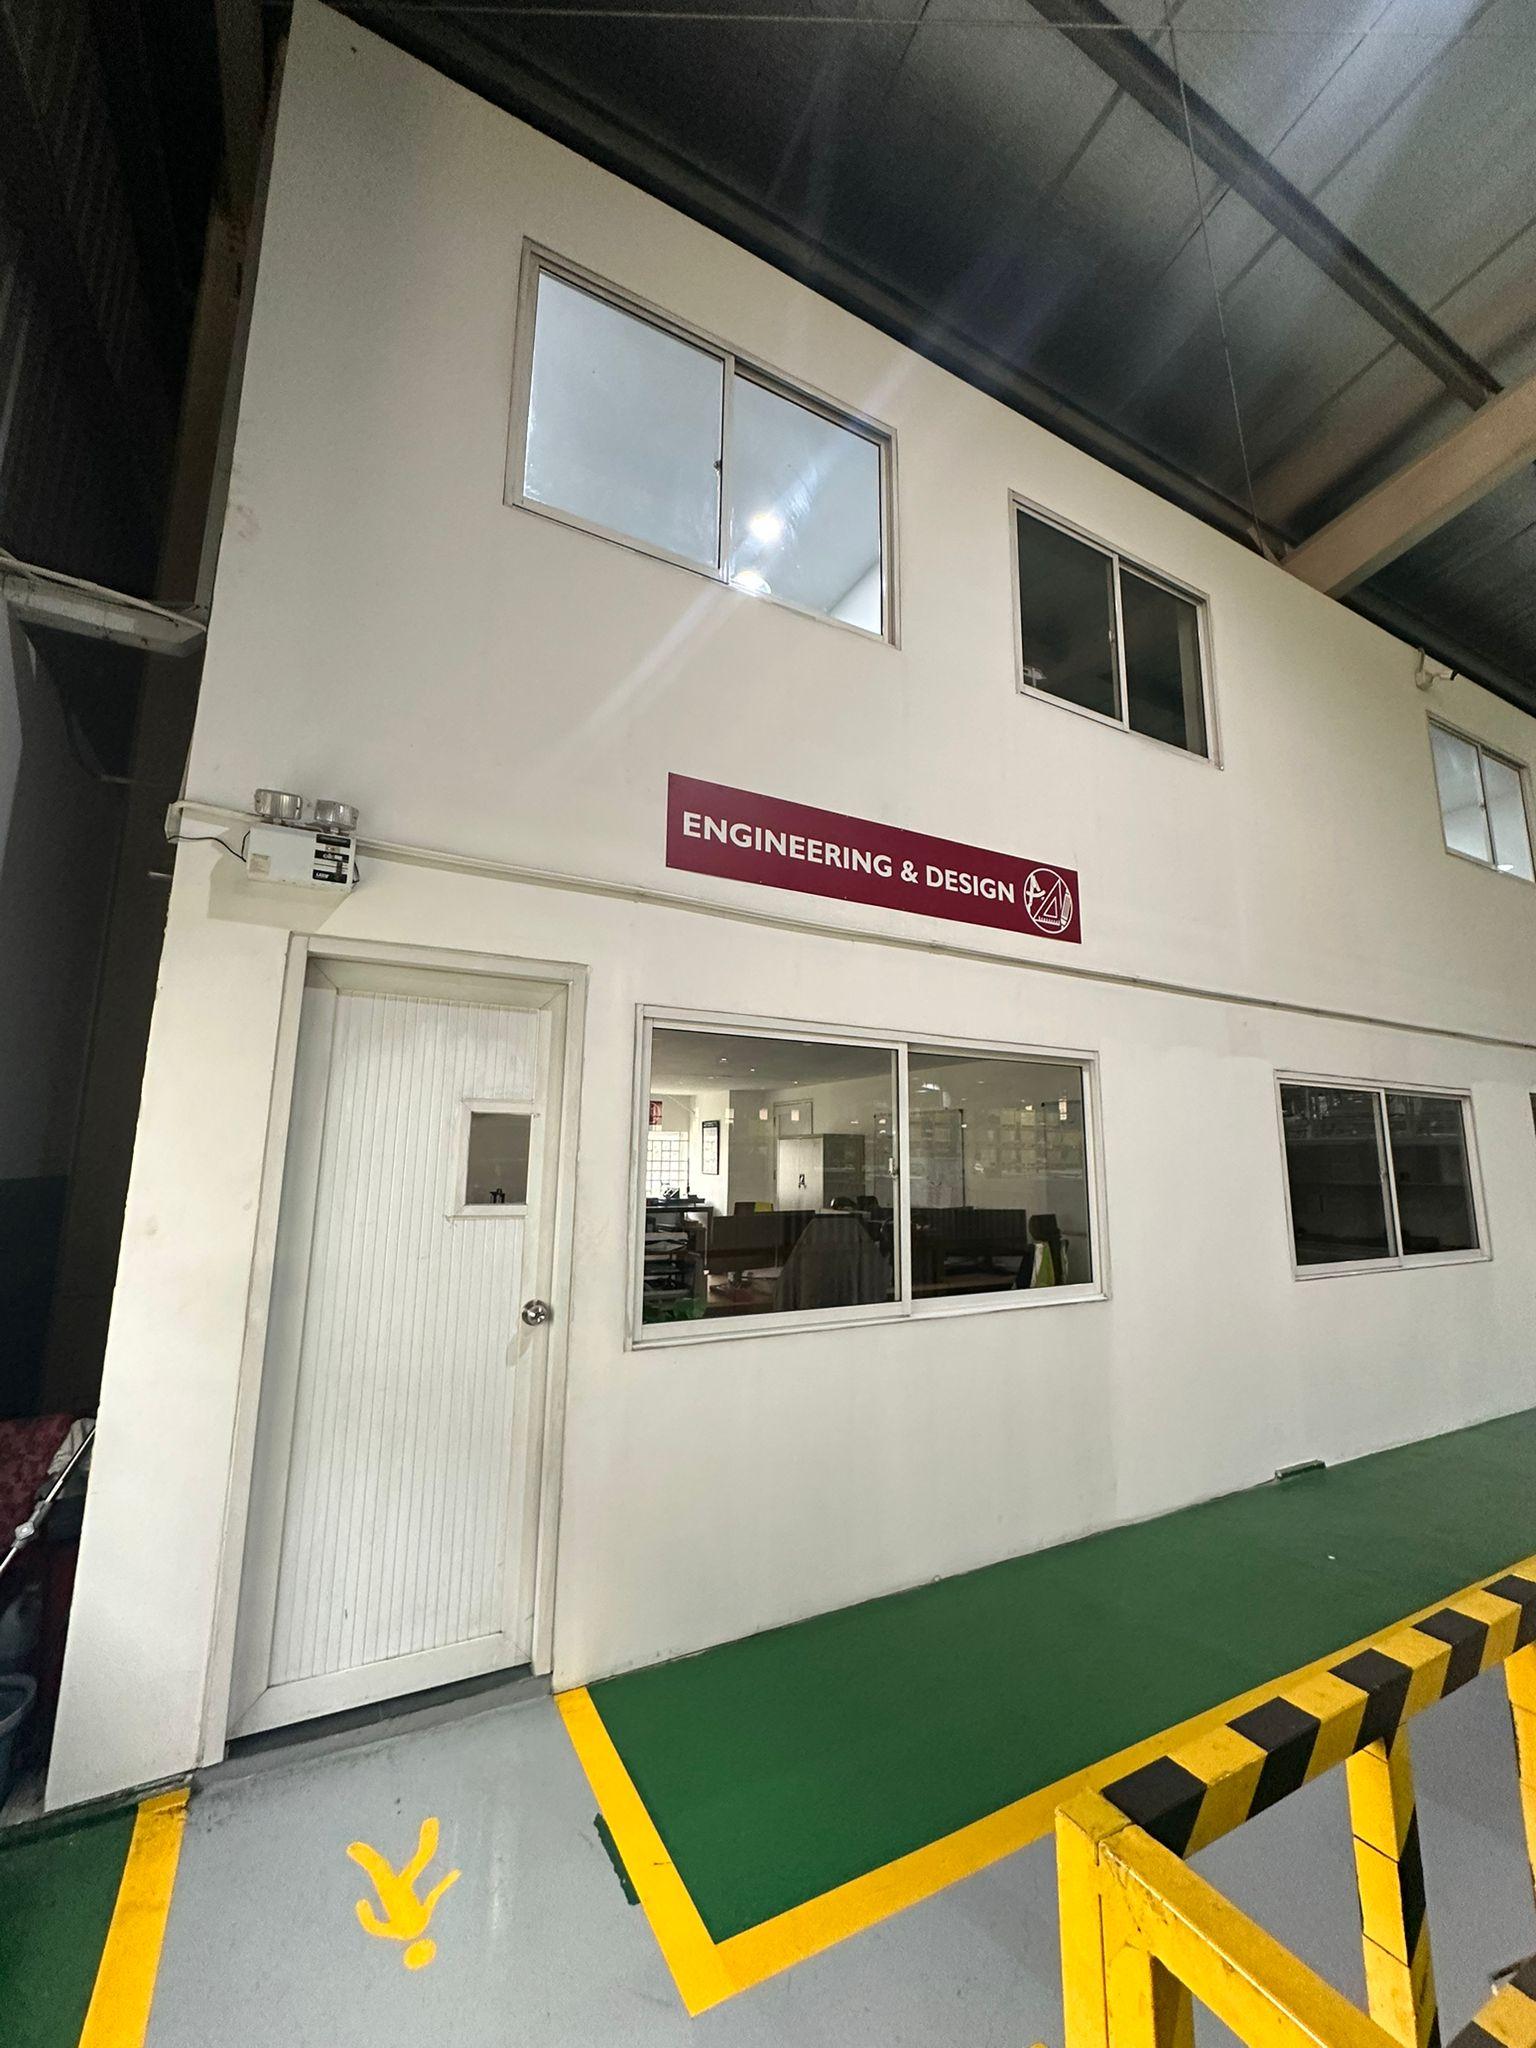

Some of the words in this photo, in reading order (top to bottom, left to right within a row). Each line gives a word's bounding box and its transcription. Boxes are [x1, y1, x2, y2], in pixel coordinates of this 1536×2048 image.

[682, 810, 893, 878] ENGINEERING
[900, 860, 919, 884] &
[926, 864, 1015, 904] DESIGN
